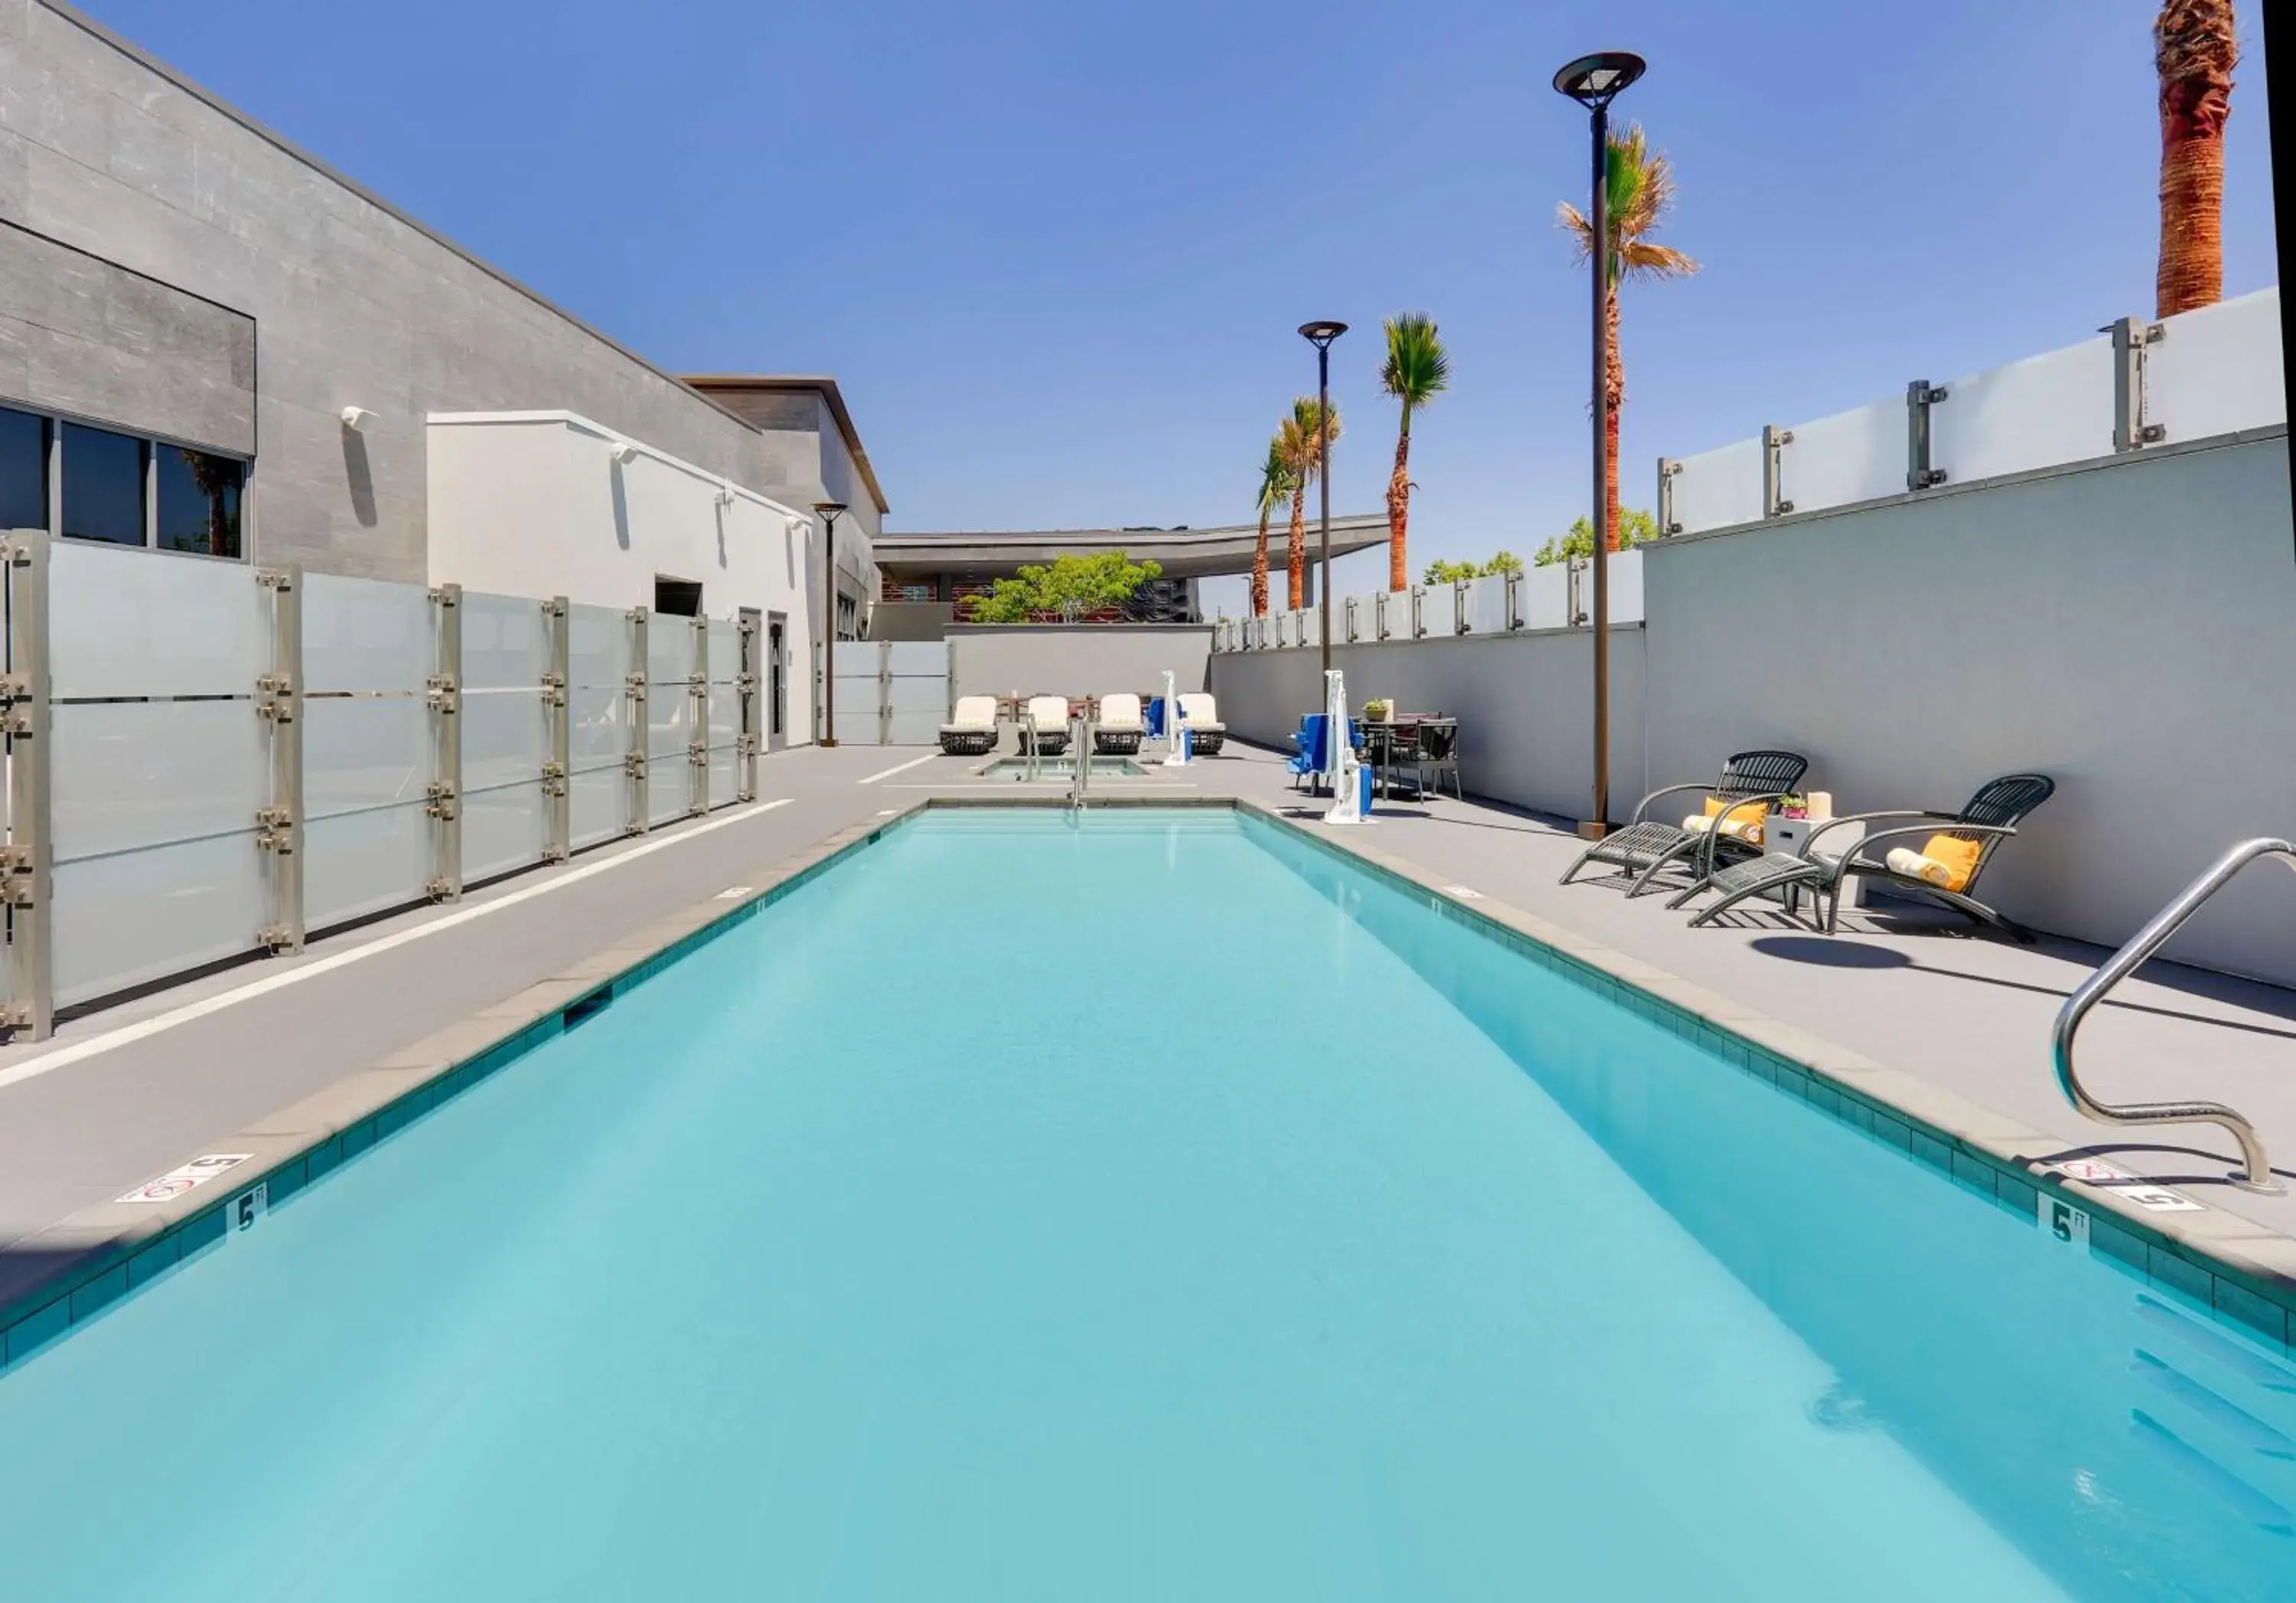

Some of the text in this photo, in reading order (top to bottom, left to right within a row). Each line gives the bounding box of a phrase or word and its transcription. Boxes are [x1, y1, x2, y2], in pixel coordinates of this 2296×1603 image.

[191, 1158, 243, 1167] 5
[2126, 1193, 2184, 1205] 5
[238, 1193, 255, 1232] 5
[2052, 1201, 2086, 1242] 5 FT
